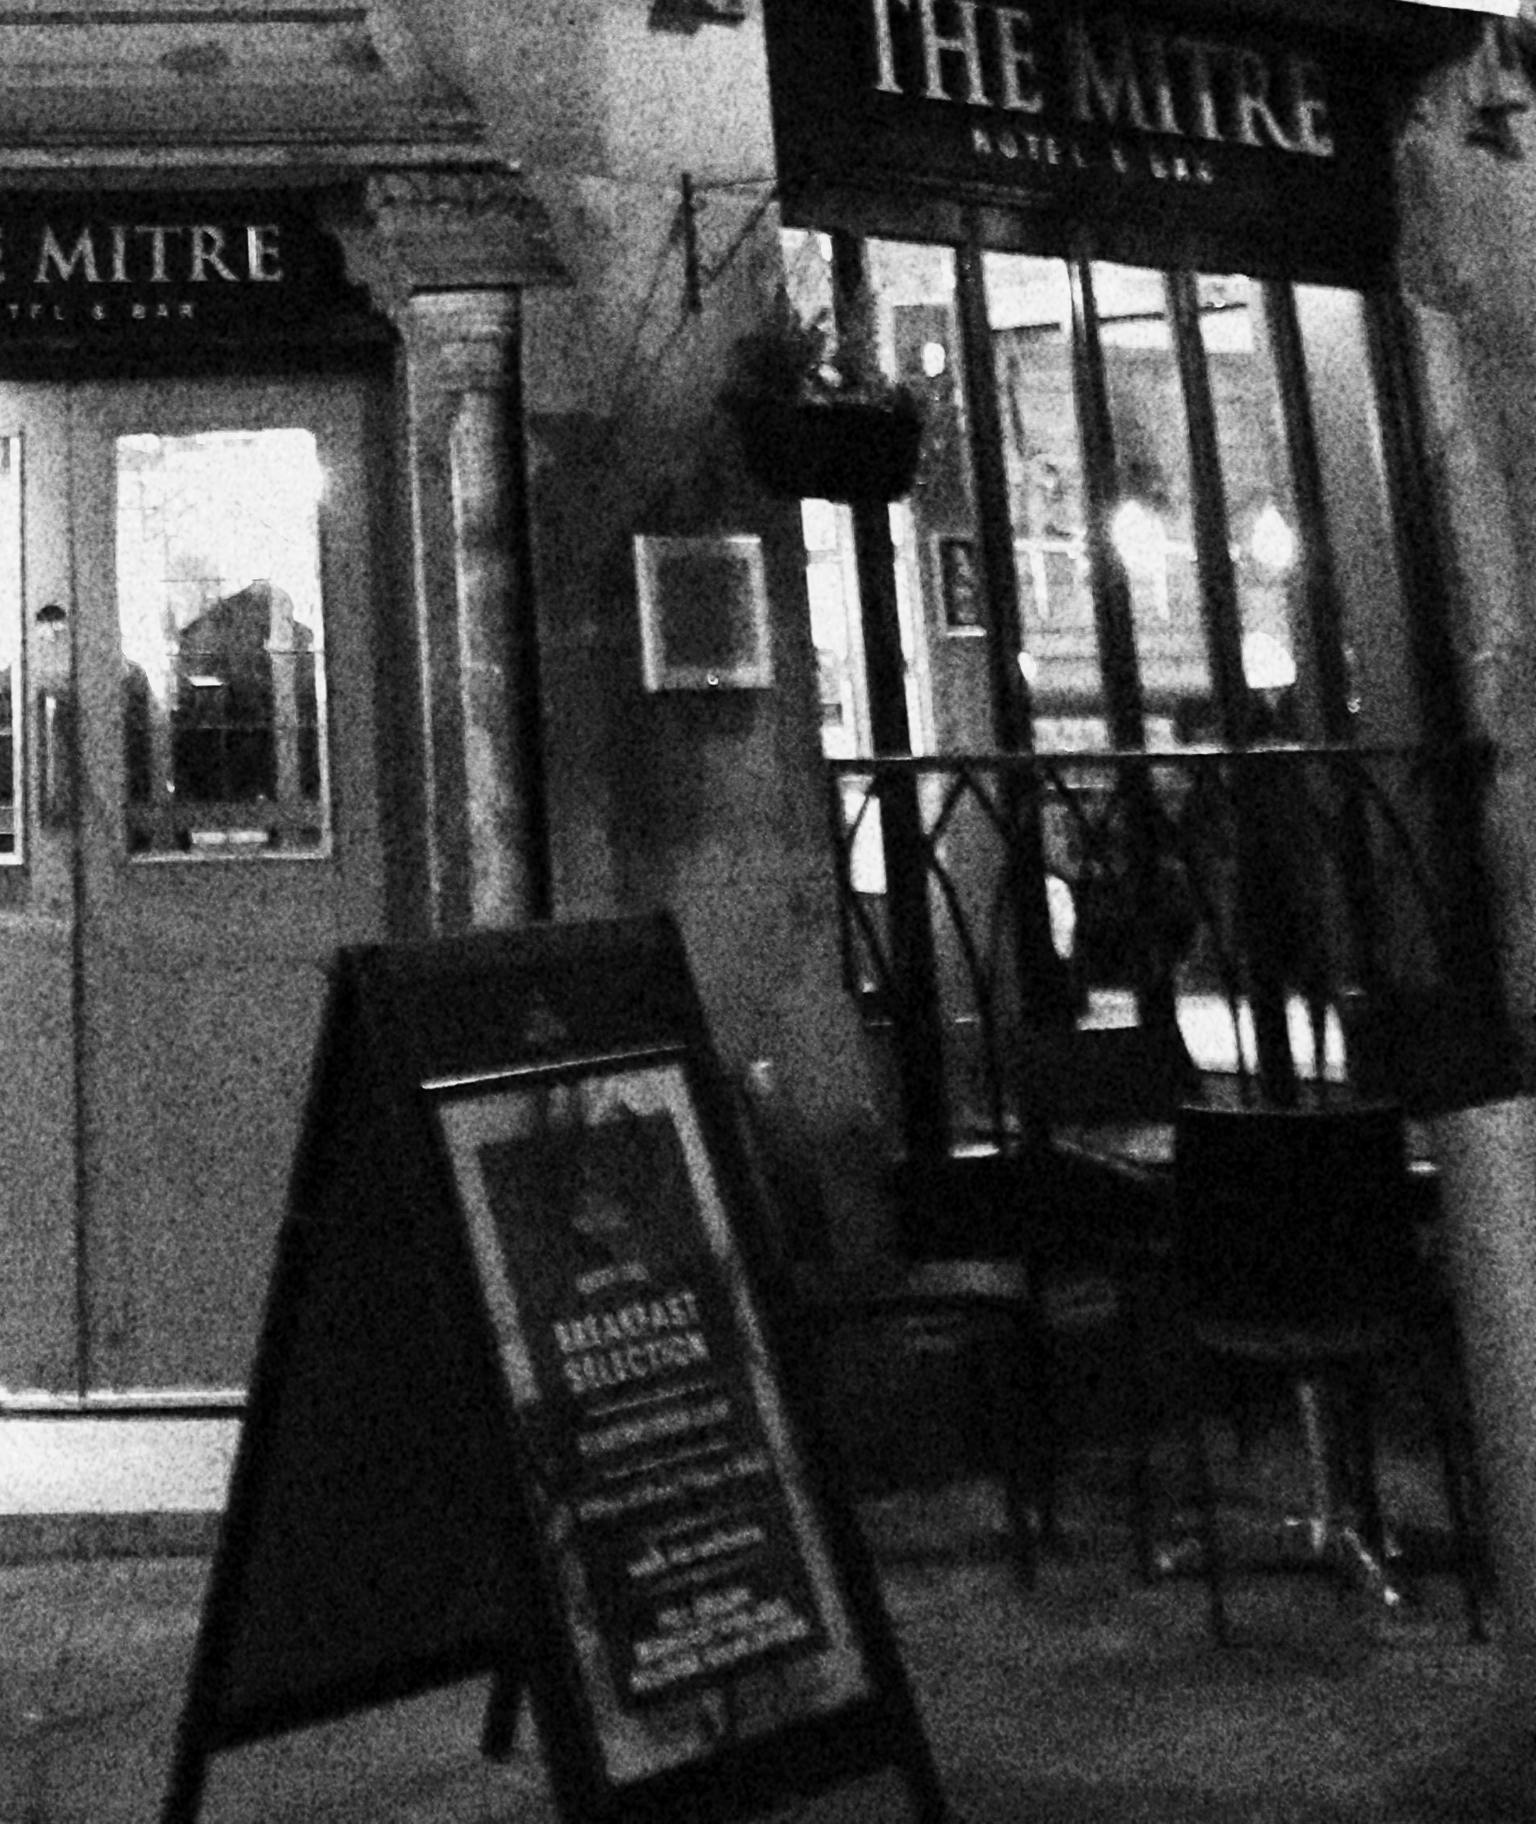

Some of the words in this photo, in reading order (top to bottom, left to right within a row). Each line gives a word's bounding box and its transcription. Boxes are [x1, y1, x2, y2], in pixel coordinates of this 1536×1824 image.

[1068, 20, 1334, 157] MITRE
[34, 225, 282, 283] MITRE
[132, 303, 194, 320] BAR
[564, 1331, 710, 1394] SELECTION
